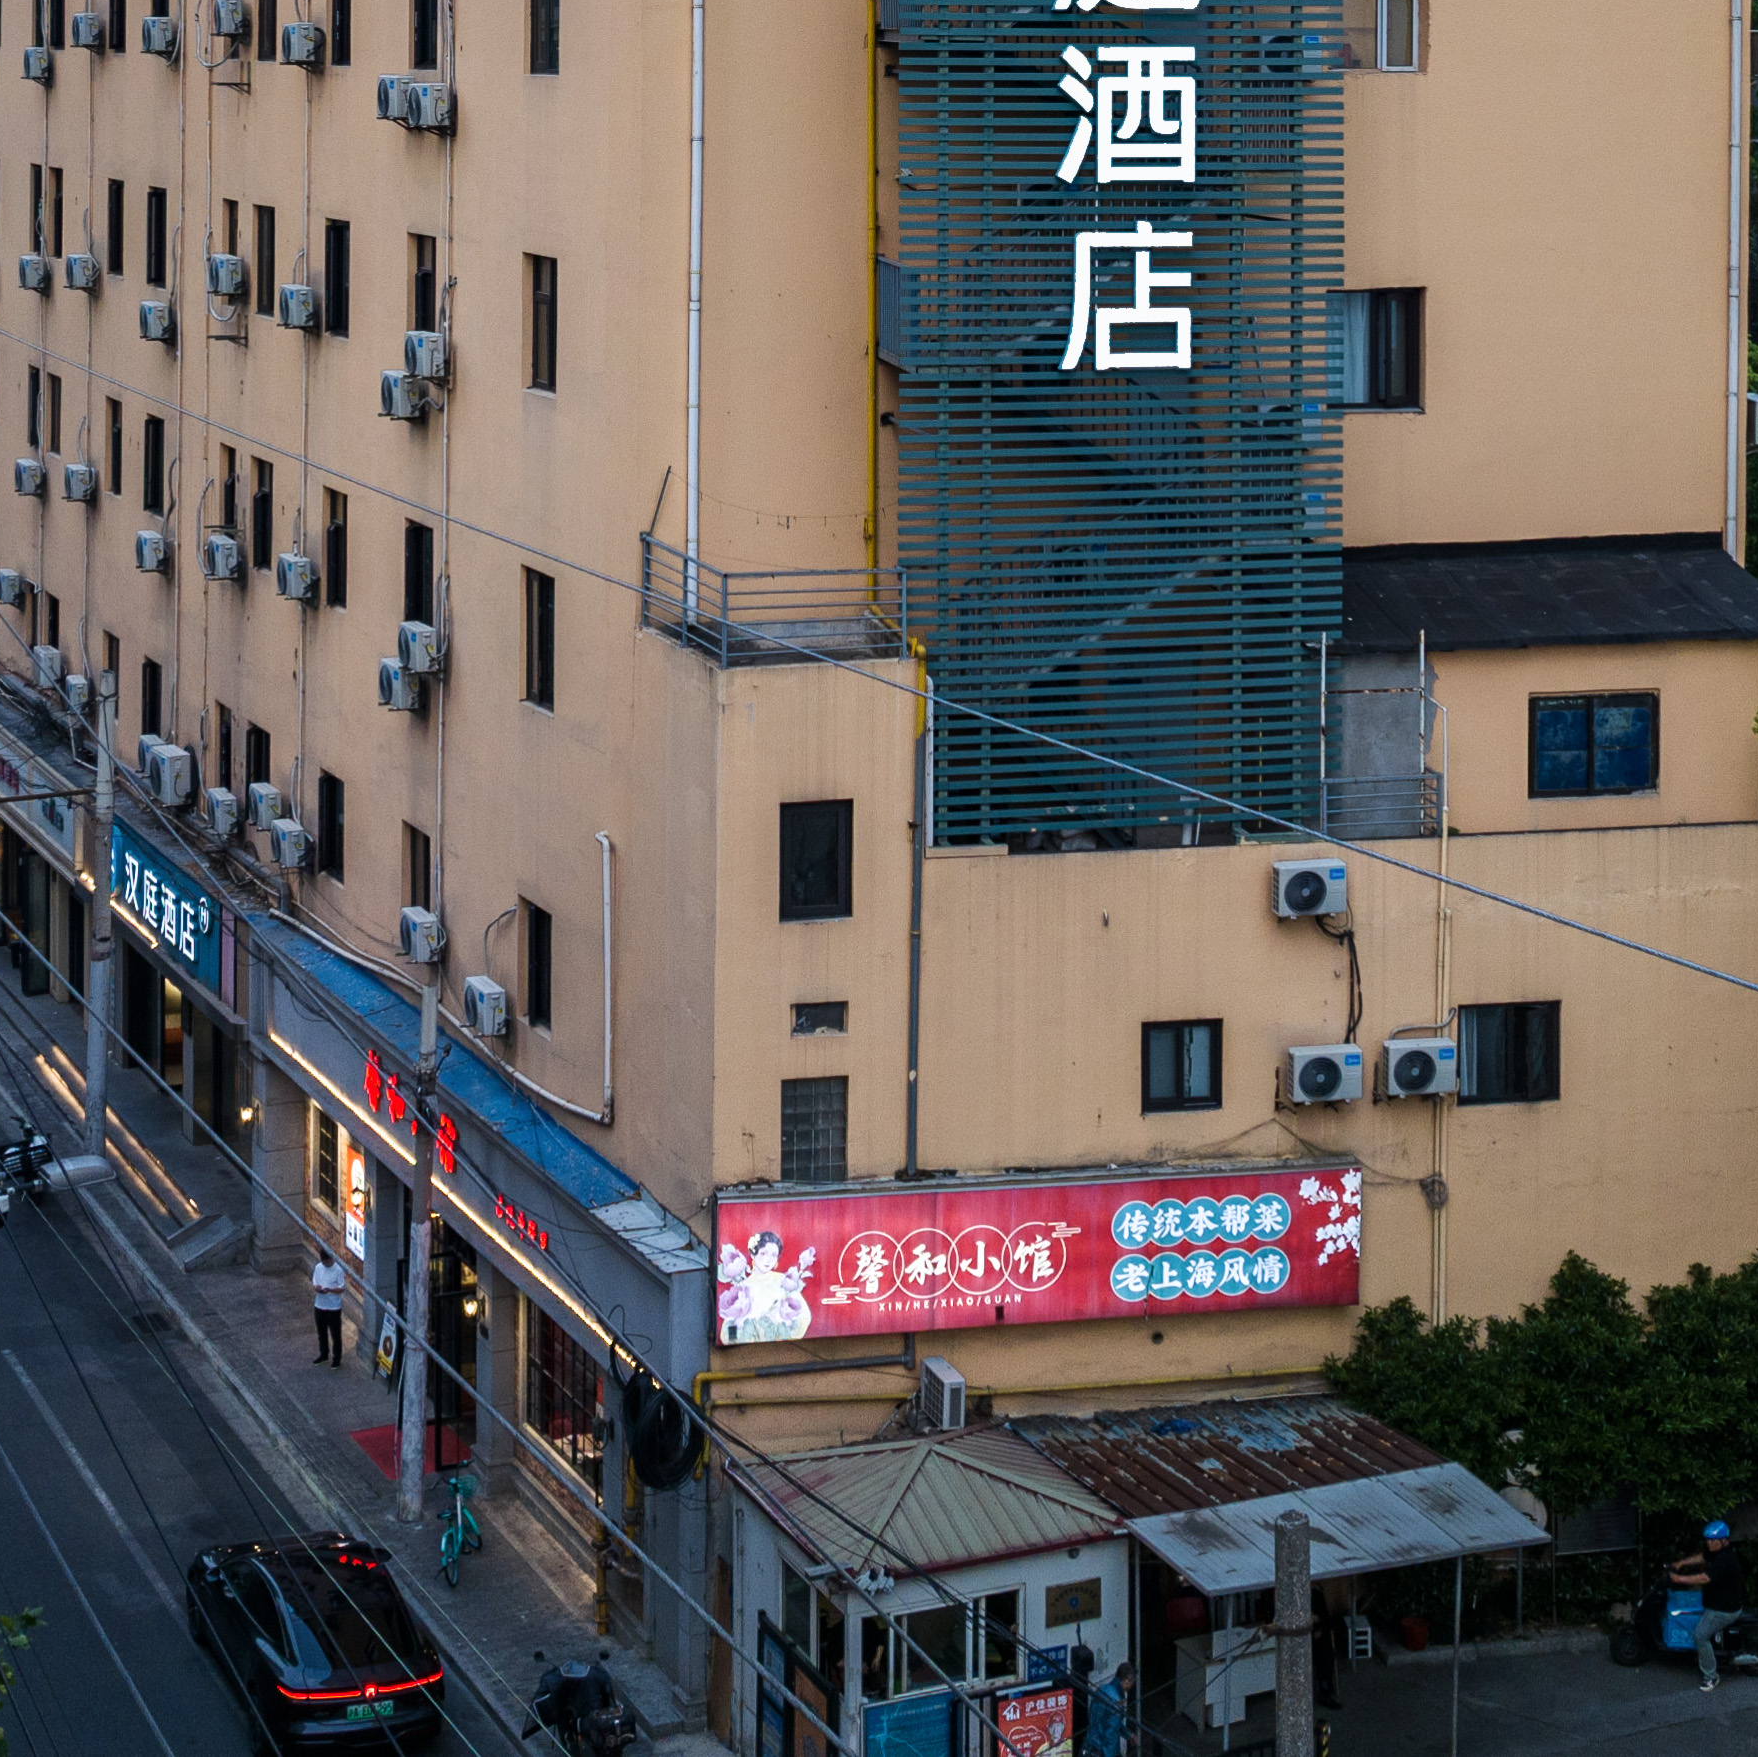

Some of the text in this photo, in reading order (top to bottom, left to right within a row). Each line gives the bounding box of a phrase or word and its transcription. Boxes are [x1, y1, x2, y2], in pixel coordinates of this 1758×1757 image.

[124, 851, 195, 962] 汉庭酒店
[1116, 1200, 1284, 1243] 传统本帮菜
[851, 1233, 1055, 1295] 馨和小馆
[1115, 1253, 1284, 1293] 老上海风情
